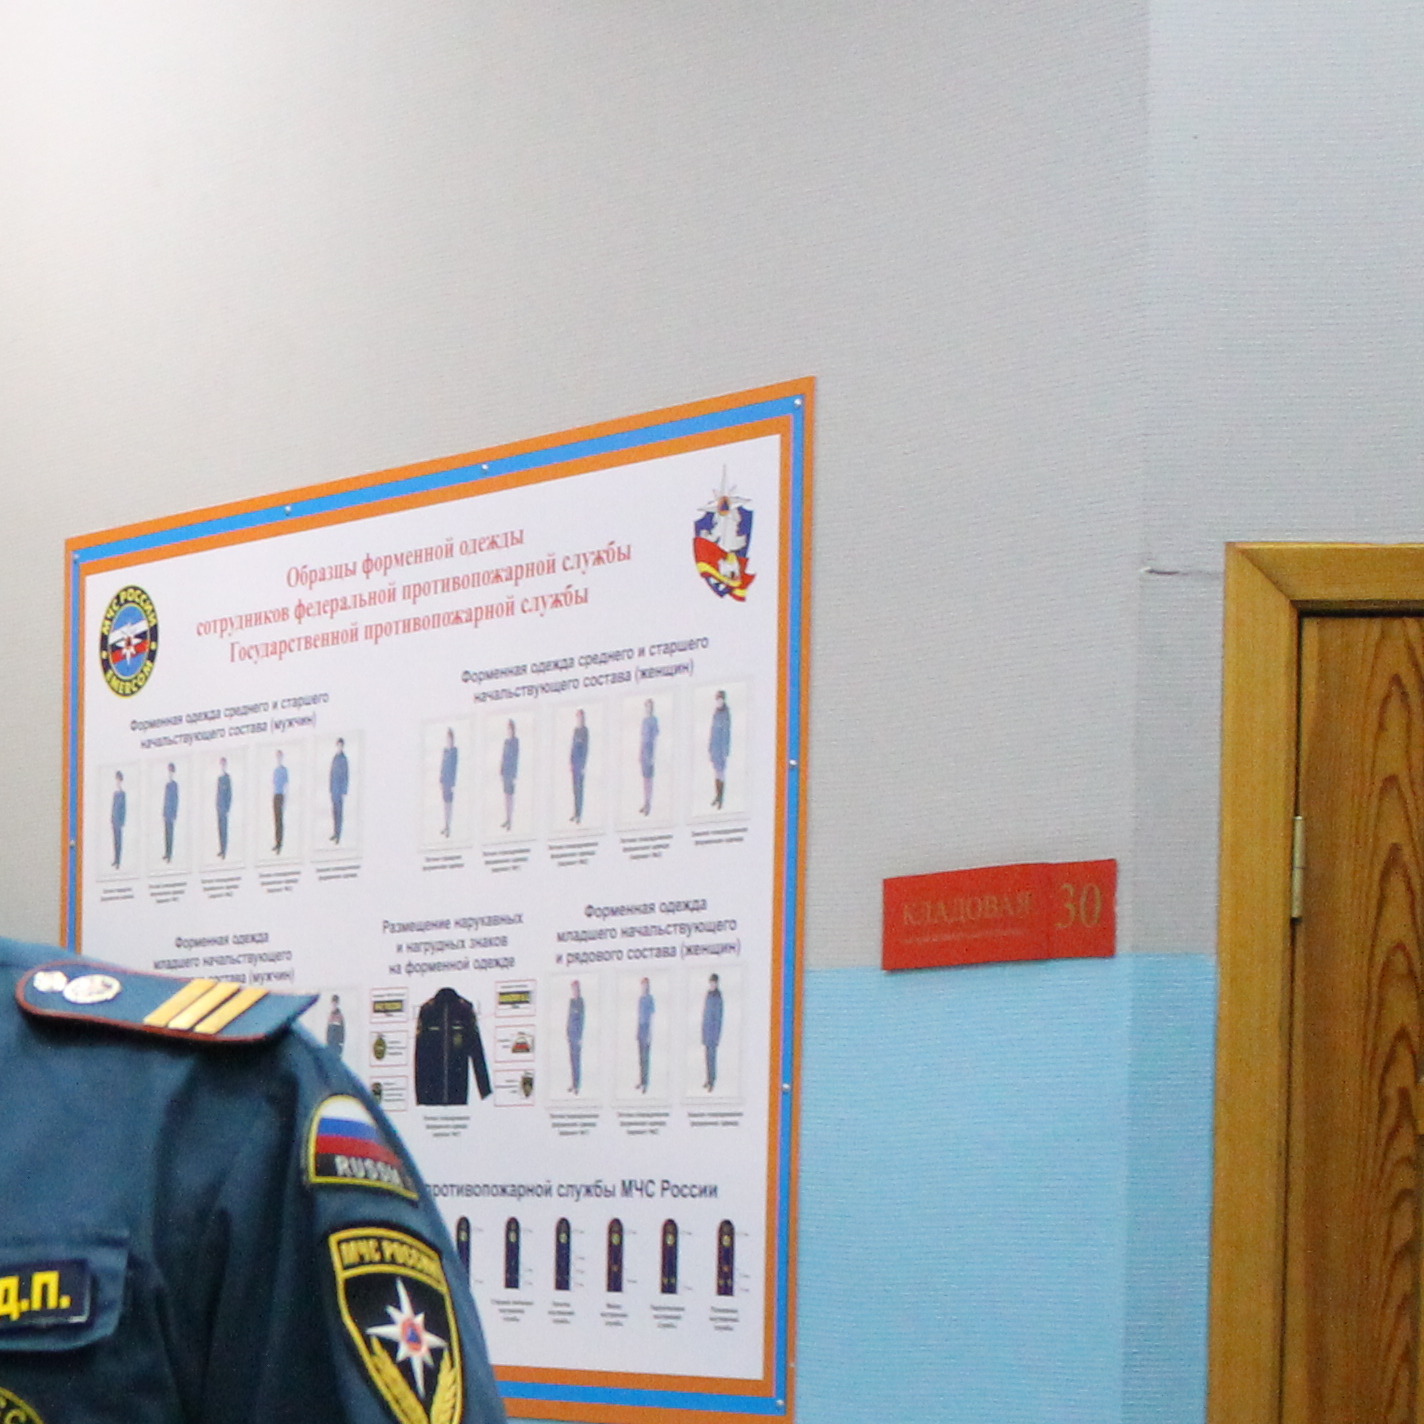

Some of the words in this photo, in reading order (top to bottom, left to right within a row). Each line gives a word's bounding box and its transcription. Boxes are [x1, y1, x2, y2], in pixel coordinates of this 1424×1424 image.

[286, 559, 357, 592] Образцы
[361, 538, 454, 579] форменной
[459, 527, 525, 558] одежды
[196, 605, 290, 639] сотрудников
[294, 581, 396, 625] федеральной
[402, 551, 555, 604] противопожарной
[562, 541, 632, 577] службы
[101, 598, 120, 636] МЧС
[229, 621, 359, 664] Государственной
[363, 594, 515, 644] противопожарной
[520, 584, 590, 620] службы
[461, 663, 527, 686] Форменная
[530, 656, 575, 676] одежда
[578, 648, 634, 671] среднего
[637, 646, 645, 658] и
[648, 635, 709, 657] старшего
[473, 677, 580, 704] начальствующего
[582, 669, 632, 687] состава
[634, 659, 695, 683] (женщин)
[130, 714, 183, 733] Форменная
[185, 707, 221, 725] одежда
[224, 702, 269, 720] среднего
[280, 692, 330, 711] старшего
[140, 727, 226, 750] начальствующего
[228, 720, 268, 736] состава
[270, 712, 317, 734] (мужчин)
[584, 902, 656, 921] Форменная
[659, 898, 707, 914] одежда
[1055, 883, 1101, 928] 30
[382, 919, 452, 934] Размещение
[454, 912, 524, 931] нарукавных
[556, 927, 618, 943] младшего
[620, 918, 738, 939] начальствующего
[175, 936, 229, 951] Форменная
[232, 932, 269, 945] одежда
[406, 939, 466, 955] нагрудных
[469, 935, 508, 949] знаков
[566, 948, 624, 967] рядового
[627, 945, 677, 960] состава
[680, 938, 741, 960] (женщин)
[154, 957, 200, 970] младшего
[203, 950, 292, 966] начальствующего
[405, 956, 470, 977] форменной
[473, 956, 515, 971] одежде
[557, 1179, 616, 1203] службы
[620, 1179, 656, 1199] МЧС
[660, 1180, 719, 1199] России
